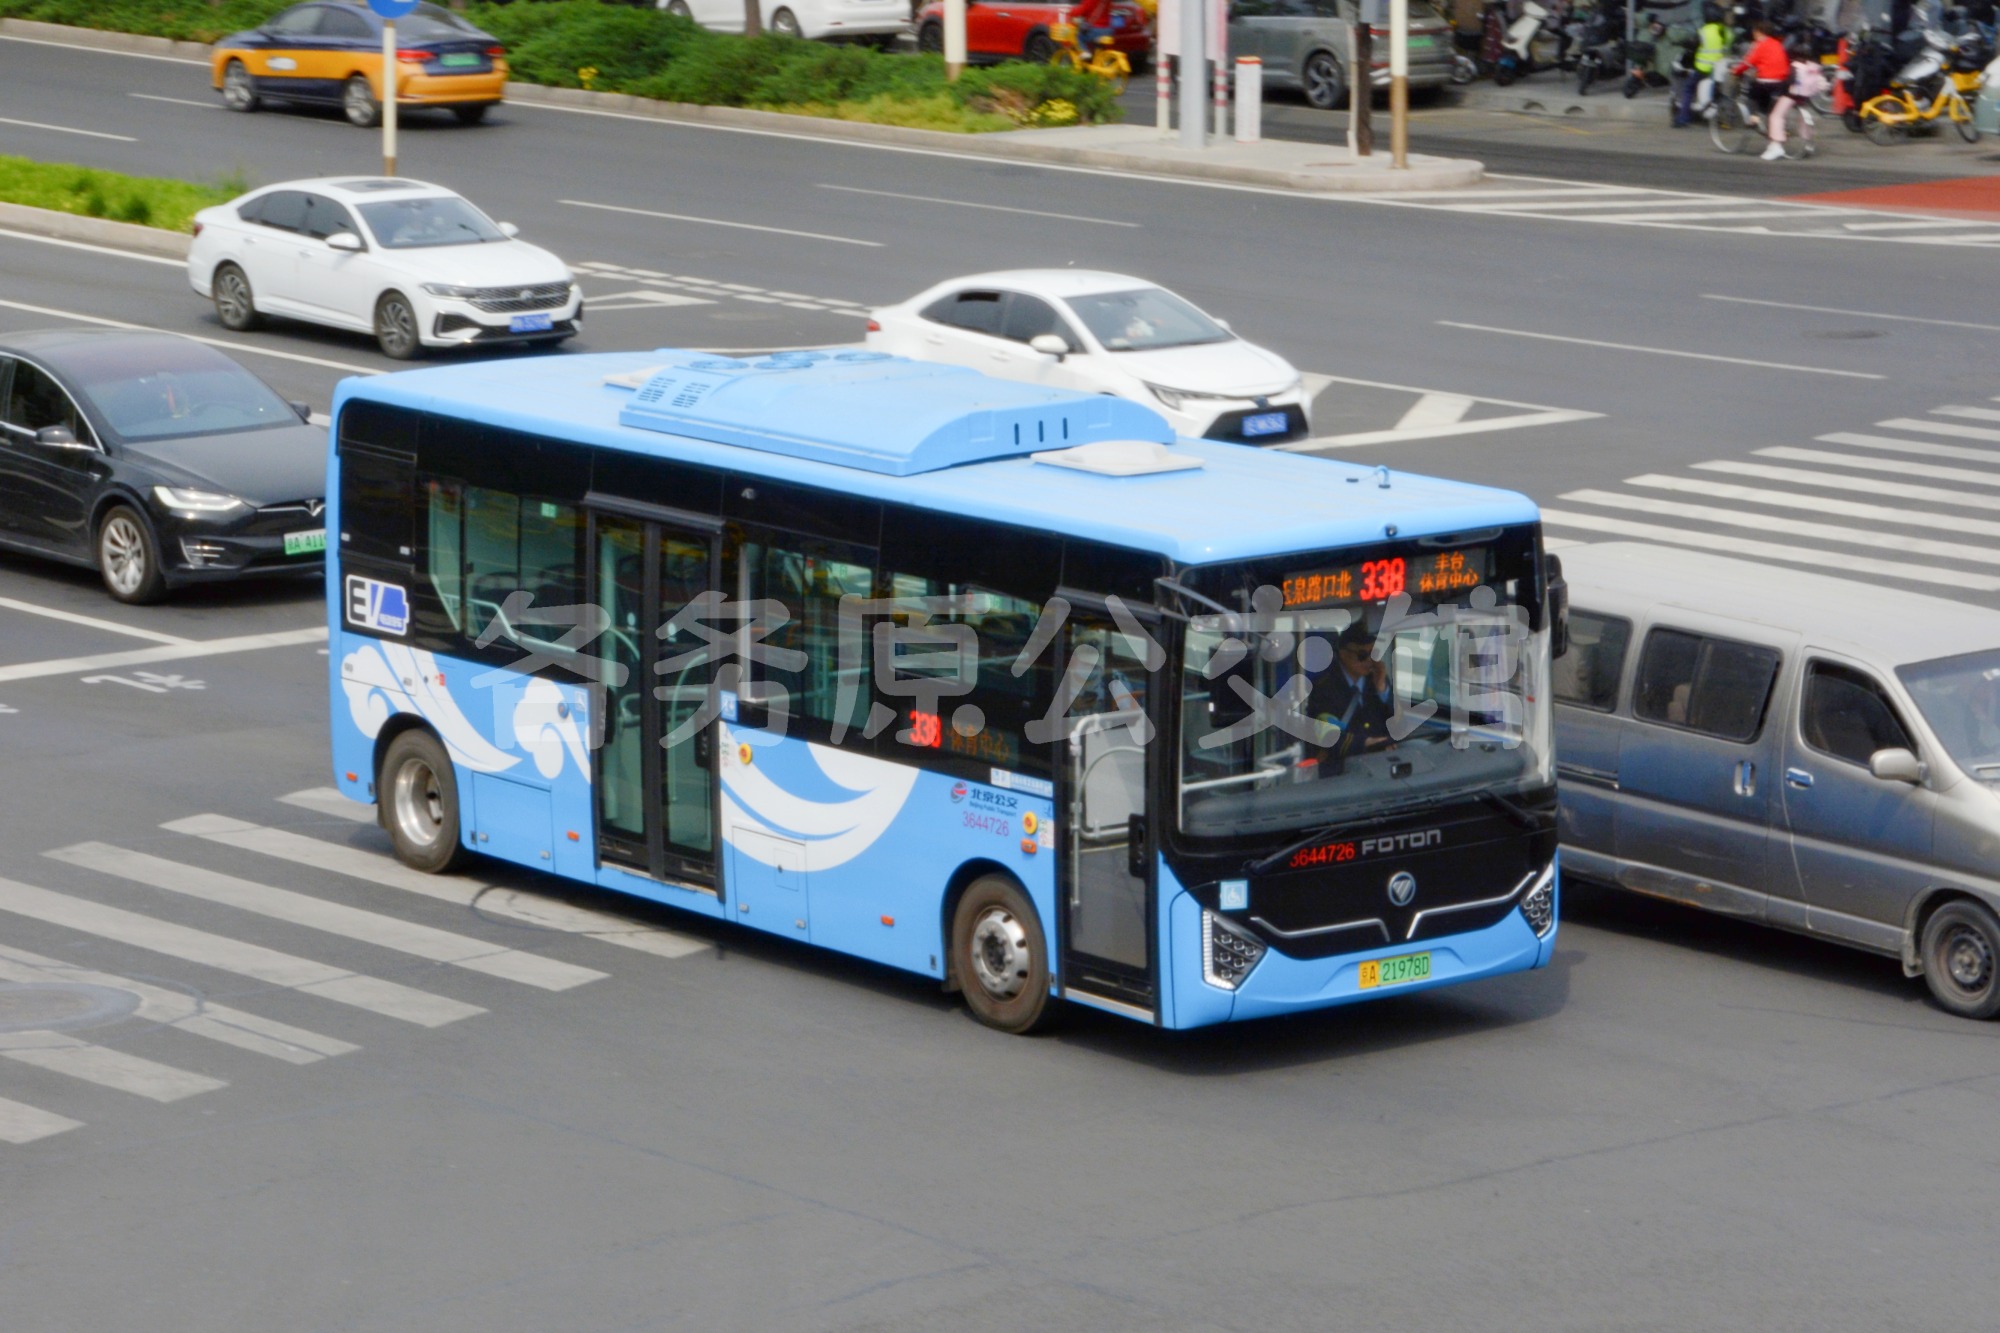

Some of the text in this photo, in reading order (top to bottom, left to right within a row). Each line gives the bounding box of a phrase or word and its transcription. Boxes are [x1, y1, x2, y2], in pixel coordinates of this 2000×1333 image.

[1435, 551, 1465, 571] 丰台
[1360, 557, 1405, 600] 338
[1419, 568, 1479, 593] 体育中心
[909, 710, 942, 748] 338
[970, 788, 1018, 809] 北京公交
[962, 810, 1009, 837] 3644726
[1290, 842, 1355, 867] 3644726
[1362, 829, 1441, 855] FOTON
[1382, 956, 1429, 981] 21978D
